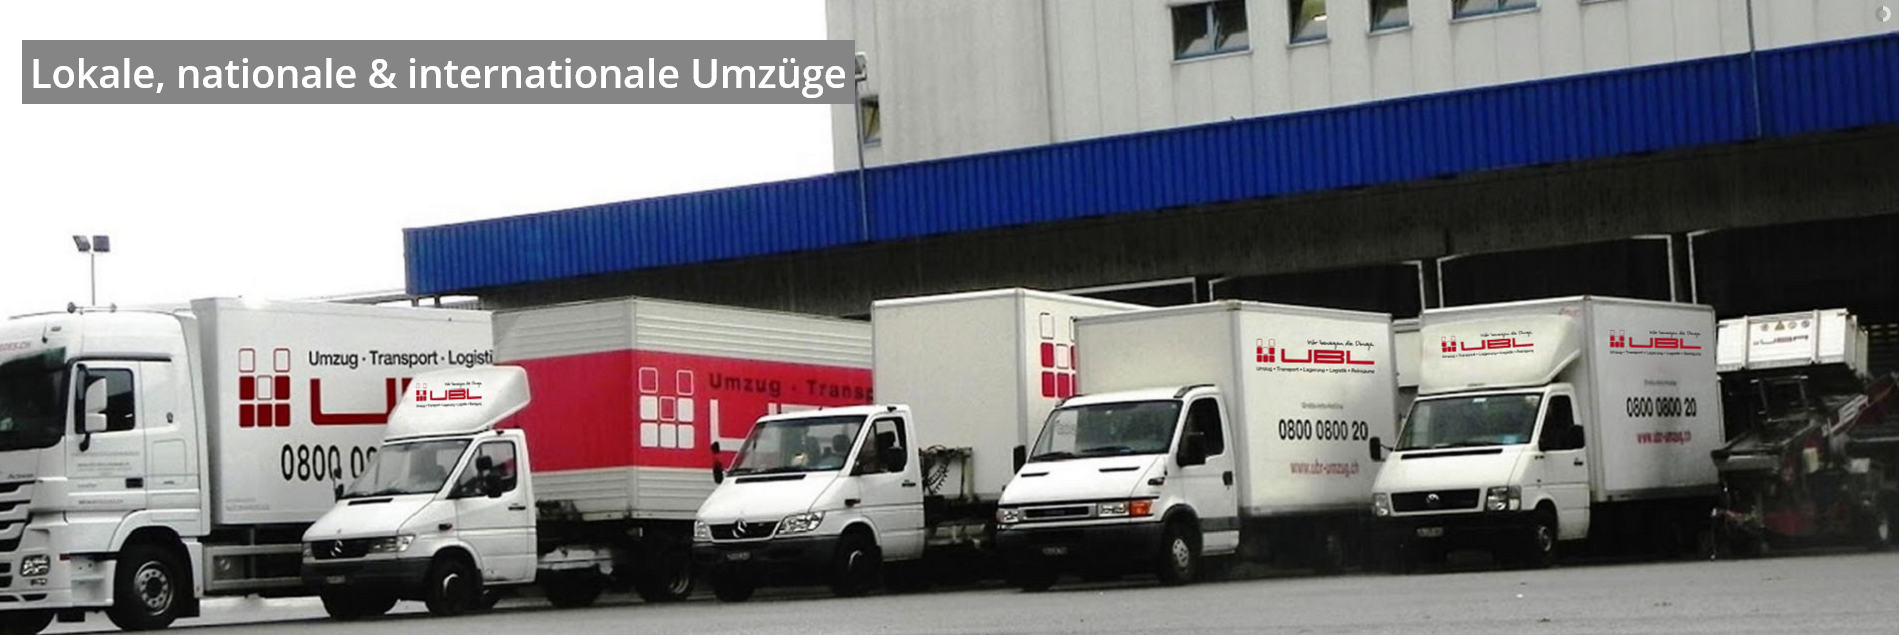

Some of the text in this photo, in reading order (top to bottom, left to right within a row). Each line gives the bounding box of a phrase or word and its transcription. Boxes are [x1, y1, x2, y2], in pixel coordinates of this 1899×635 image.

[1319, 339, 1344, 350] bewegen
[1355, 340, 1374, 350] Dinge
[1460, 338, 1534, 351] UBL
[1628, 336, 1701, 349] UBL
[308, 349, 493, 369] Umzug Transport Logisti
[1281, 348, 1374, 364] UBL
[430, 388, 482, 400] UBL
[708, 372, 781, 398] Umzug
[1626, 396, 1697, 418] 0800 0800 20
[1278, 418, 1369, 441] 0800 0800 20
[281, 444, 341, 481] 0800
